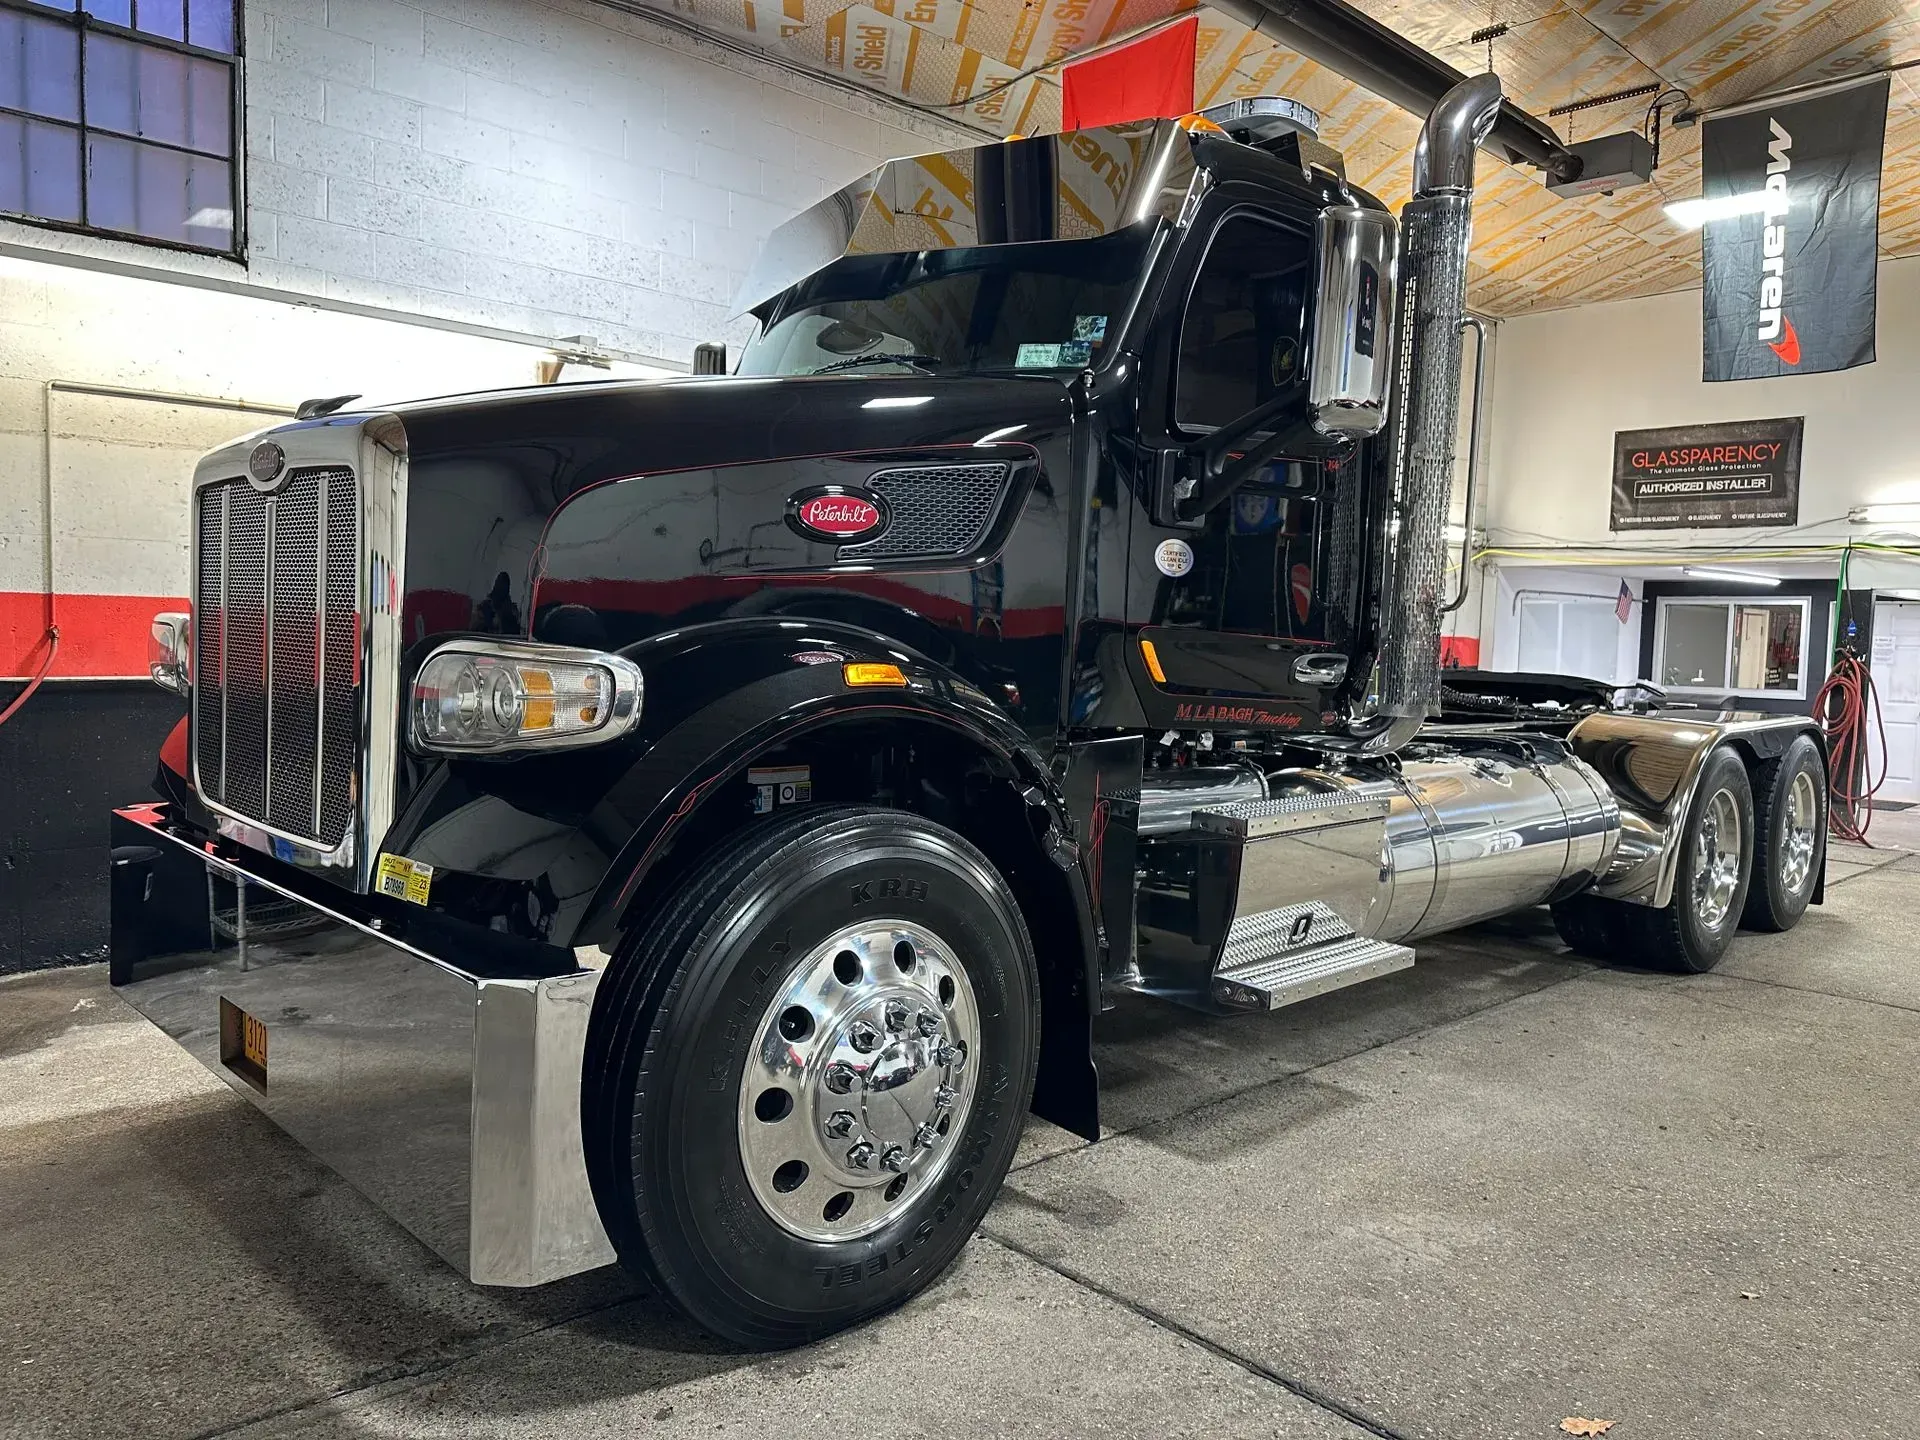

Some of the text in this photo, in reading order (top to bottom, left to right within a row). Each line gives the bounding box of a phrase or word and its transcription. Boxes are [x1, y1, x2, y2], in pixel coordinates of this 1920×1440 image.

[854, 24, 888, 71] Shield
[1631, 442, 1781, 468] GLASSPARENCY
[1664, 466, 1696, 474] Ultimate
[1720, 463, 1762, 471] Protection
[1639, 478, 1767, 494] AUTHORIZED INSTALLER
[809, 501, 872, 523] Peterbilt
[1251, 710, 1303, 729] Trucking
[848, 877, 929, 906] KRH
